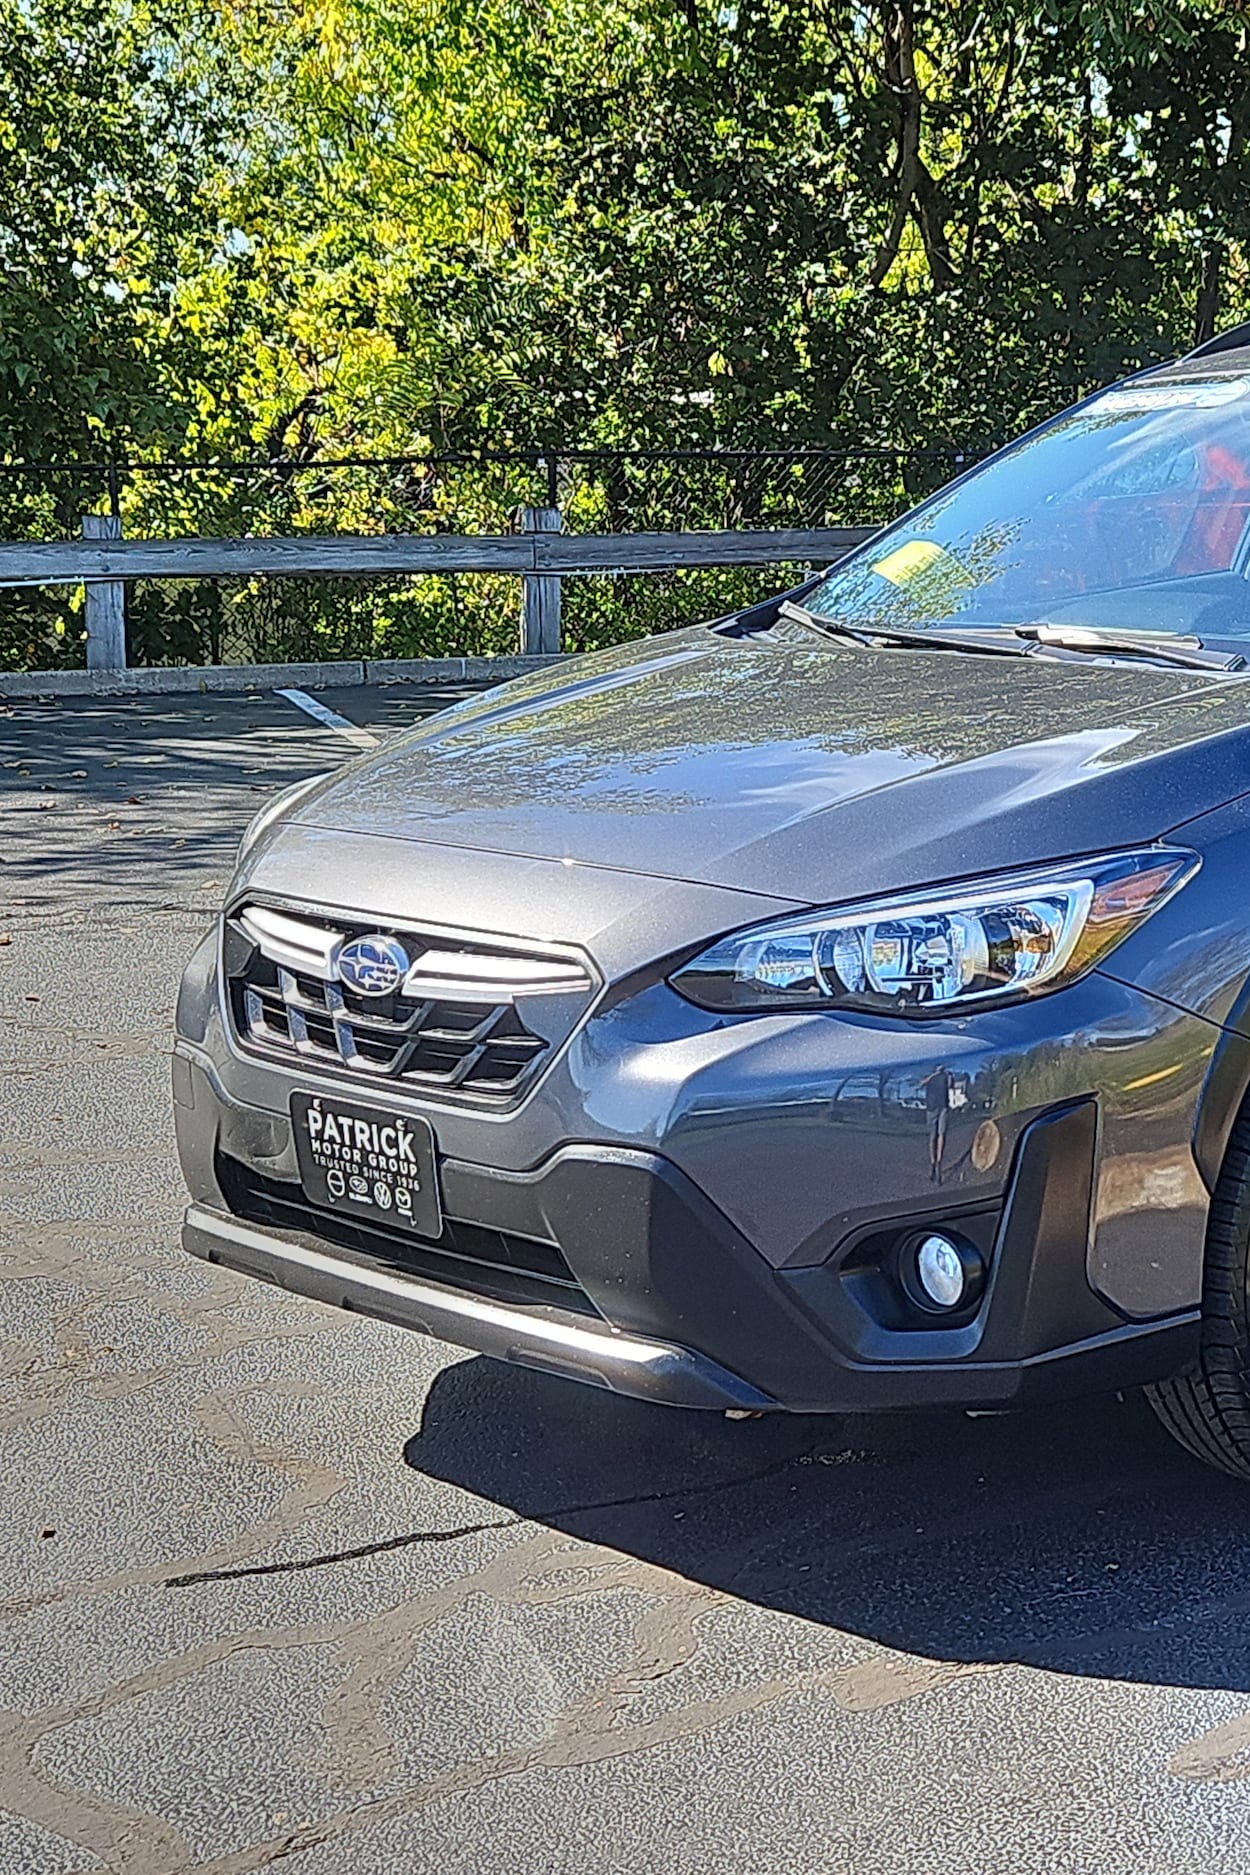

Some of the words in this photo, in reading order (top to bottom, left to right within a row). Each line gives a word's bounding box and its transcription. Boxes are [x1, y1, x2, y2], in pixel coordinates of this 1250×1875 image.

[307, 1108, 417, 1163] PATRICK
[311, 1138, 362, 1164] MOTOR
[368, 1152, 418, 1177] GROUP
[313, 1153, 360, 1175] TRUSTED
[362, 1166, 394, 1184] SINCE
